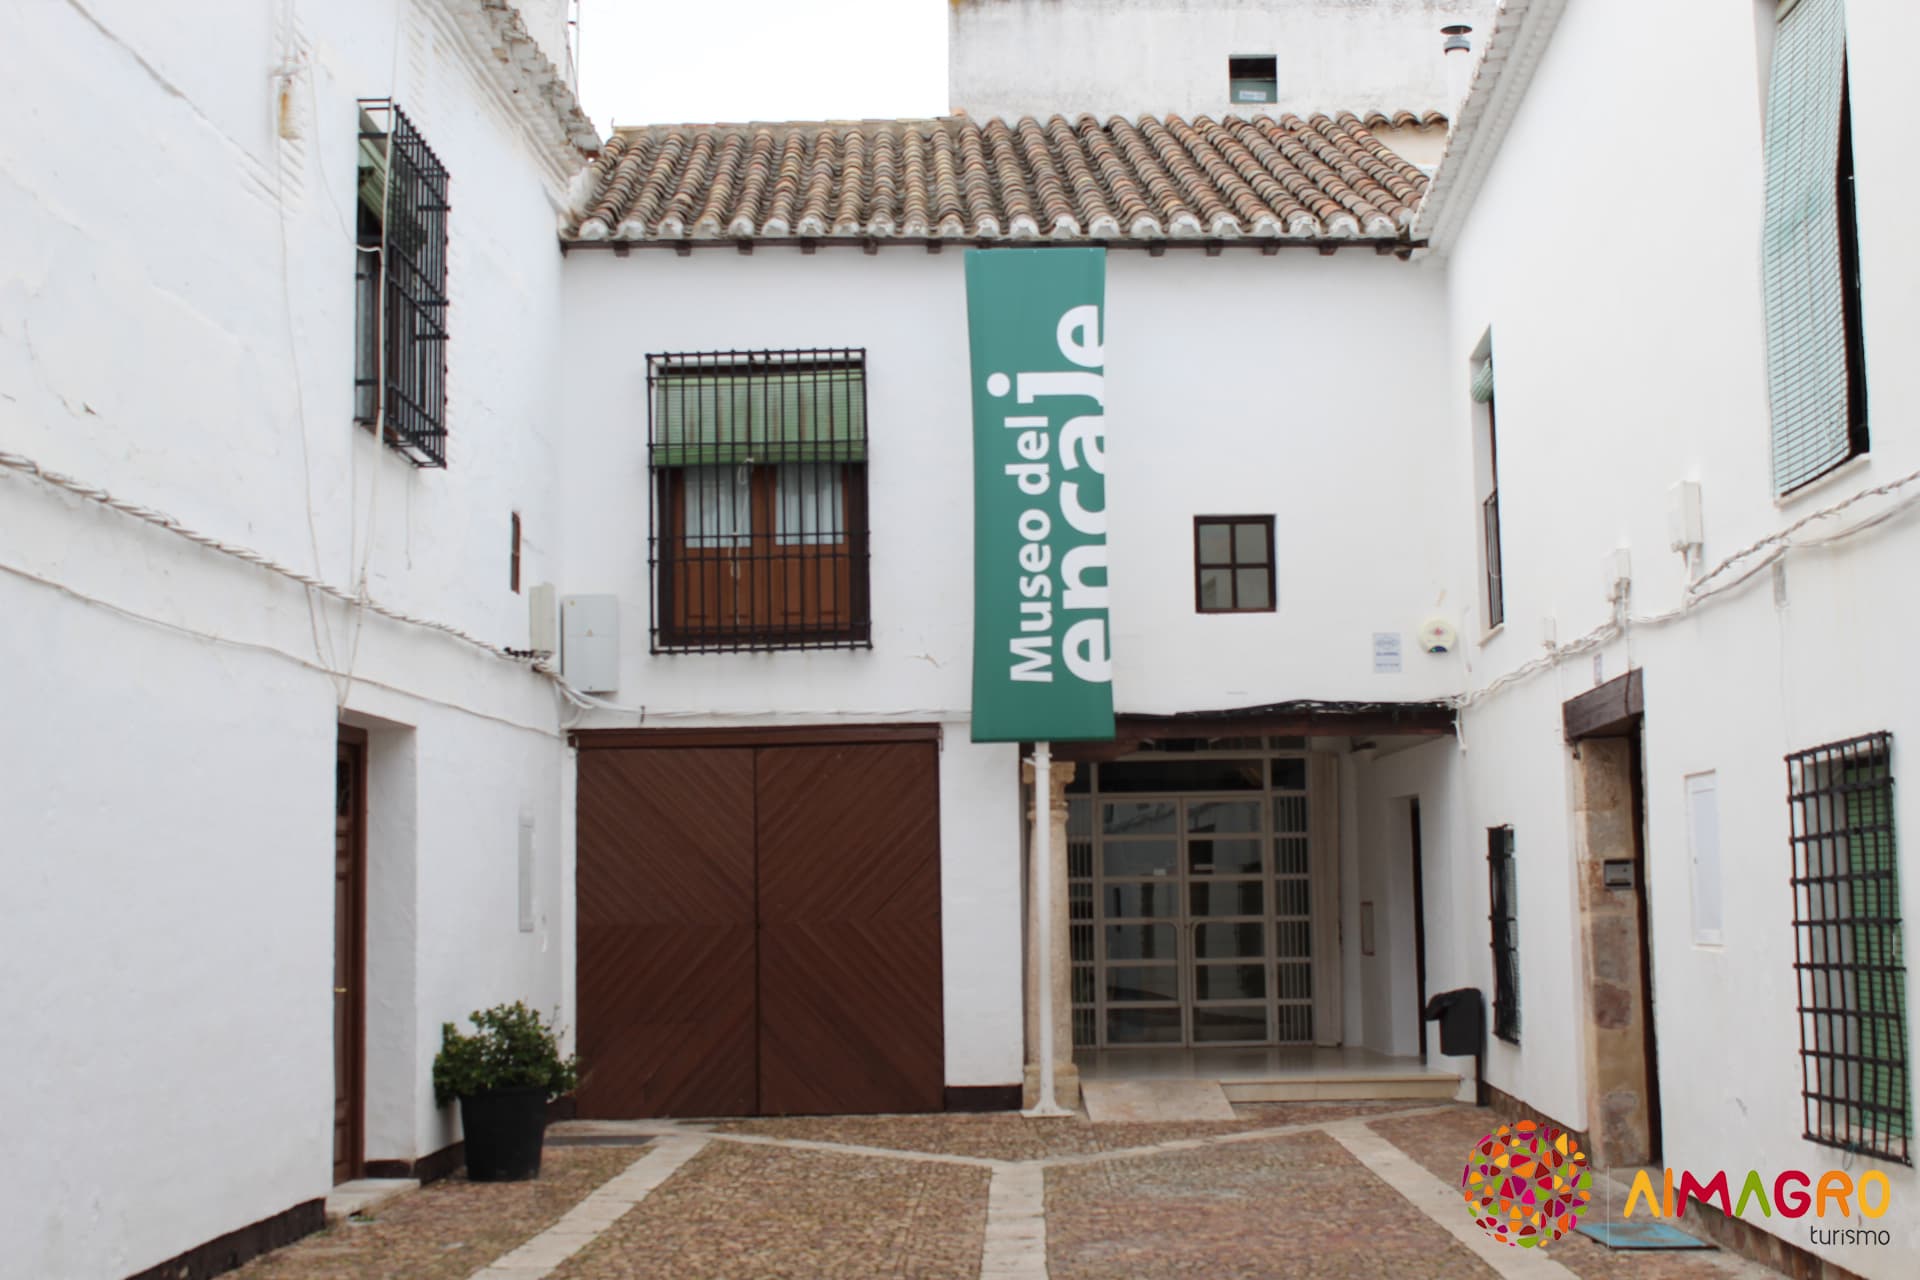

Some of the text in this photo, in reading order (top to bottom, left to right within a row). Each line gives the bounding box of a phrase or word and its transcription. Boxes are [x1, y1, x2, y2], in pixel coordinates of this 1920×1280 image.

[987, 304, 1112, 683] encaje
[1004, 416, 1053, 682] Museo del
